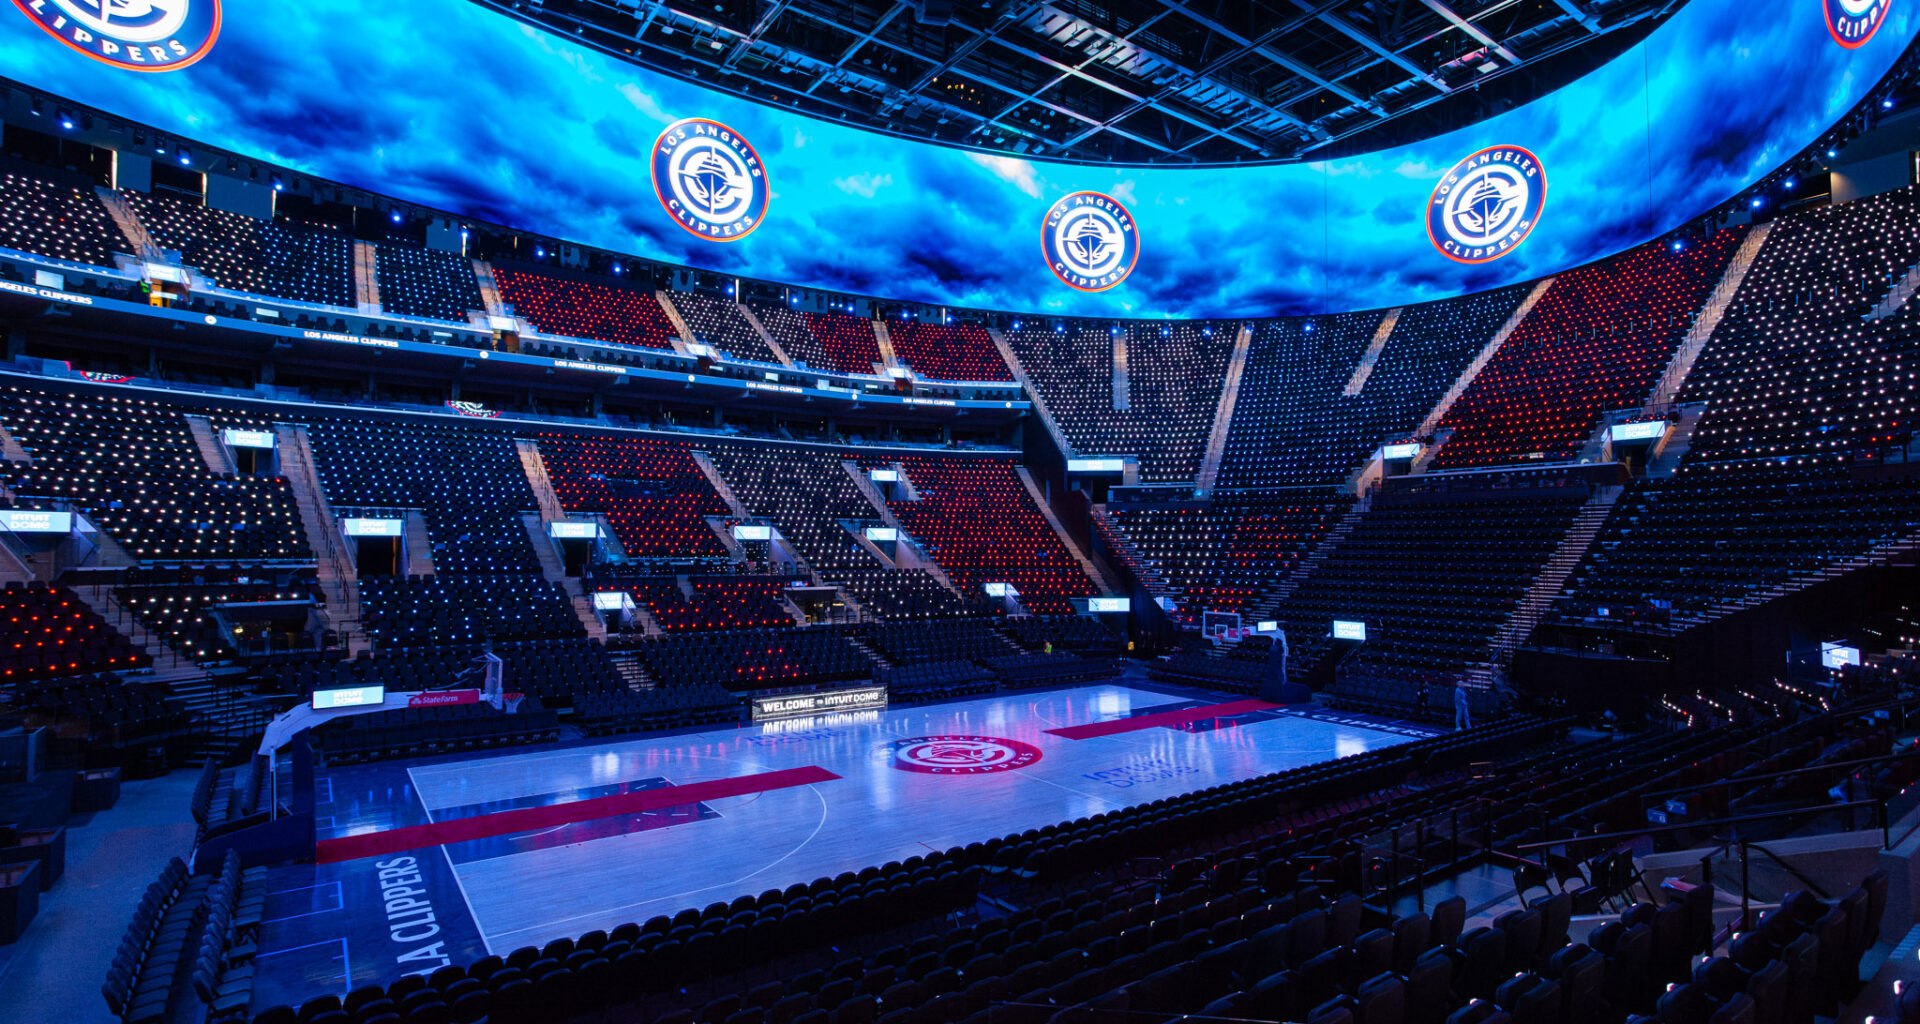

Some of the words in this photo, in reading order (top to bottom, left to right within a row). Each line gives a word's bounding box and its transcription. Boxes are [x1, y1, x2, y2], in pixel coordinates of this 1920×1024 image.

[661, 129, 686, 155] LOS
[695, 124, 762, 177] ANGELES
[1435, 174, 1459, 205] LOS
[1468, 151, 1537, 178] ANGELES
[668, 199, 754, 235] CLIPPERS
[1048, 204, 1068, 228] LOS
[1075, 196, 1132, 232] ANGELES
[1443, 218, 1530, 258] CLIPPERS
[1055, 262, 1126, 288] CLIPPERS
[38, 288, 93, 305] CLIPPERS
[303, 330, 321, 339] LOS
[321, 332, 359, 344] ANGELES
[360, 337, 399, 348] CLIPPERS
[567, 361, 596, 371] ANGELES
[597, 365, 626, 374] CLIPPERS
[763, 698, 815, 712] WELCOME
[825, 694, 853, 706] INTUIT
[854, 692, 879, 703] DOME
[931, 752, 1034, 773] CLIPPERS
[375, 856, 440, 942] CLIPPERS
